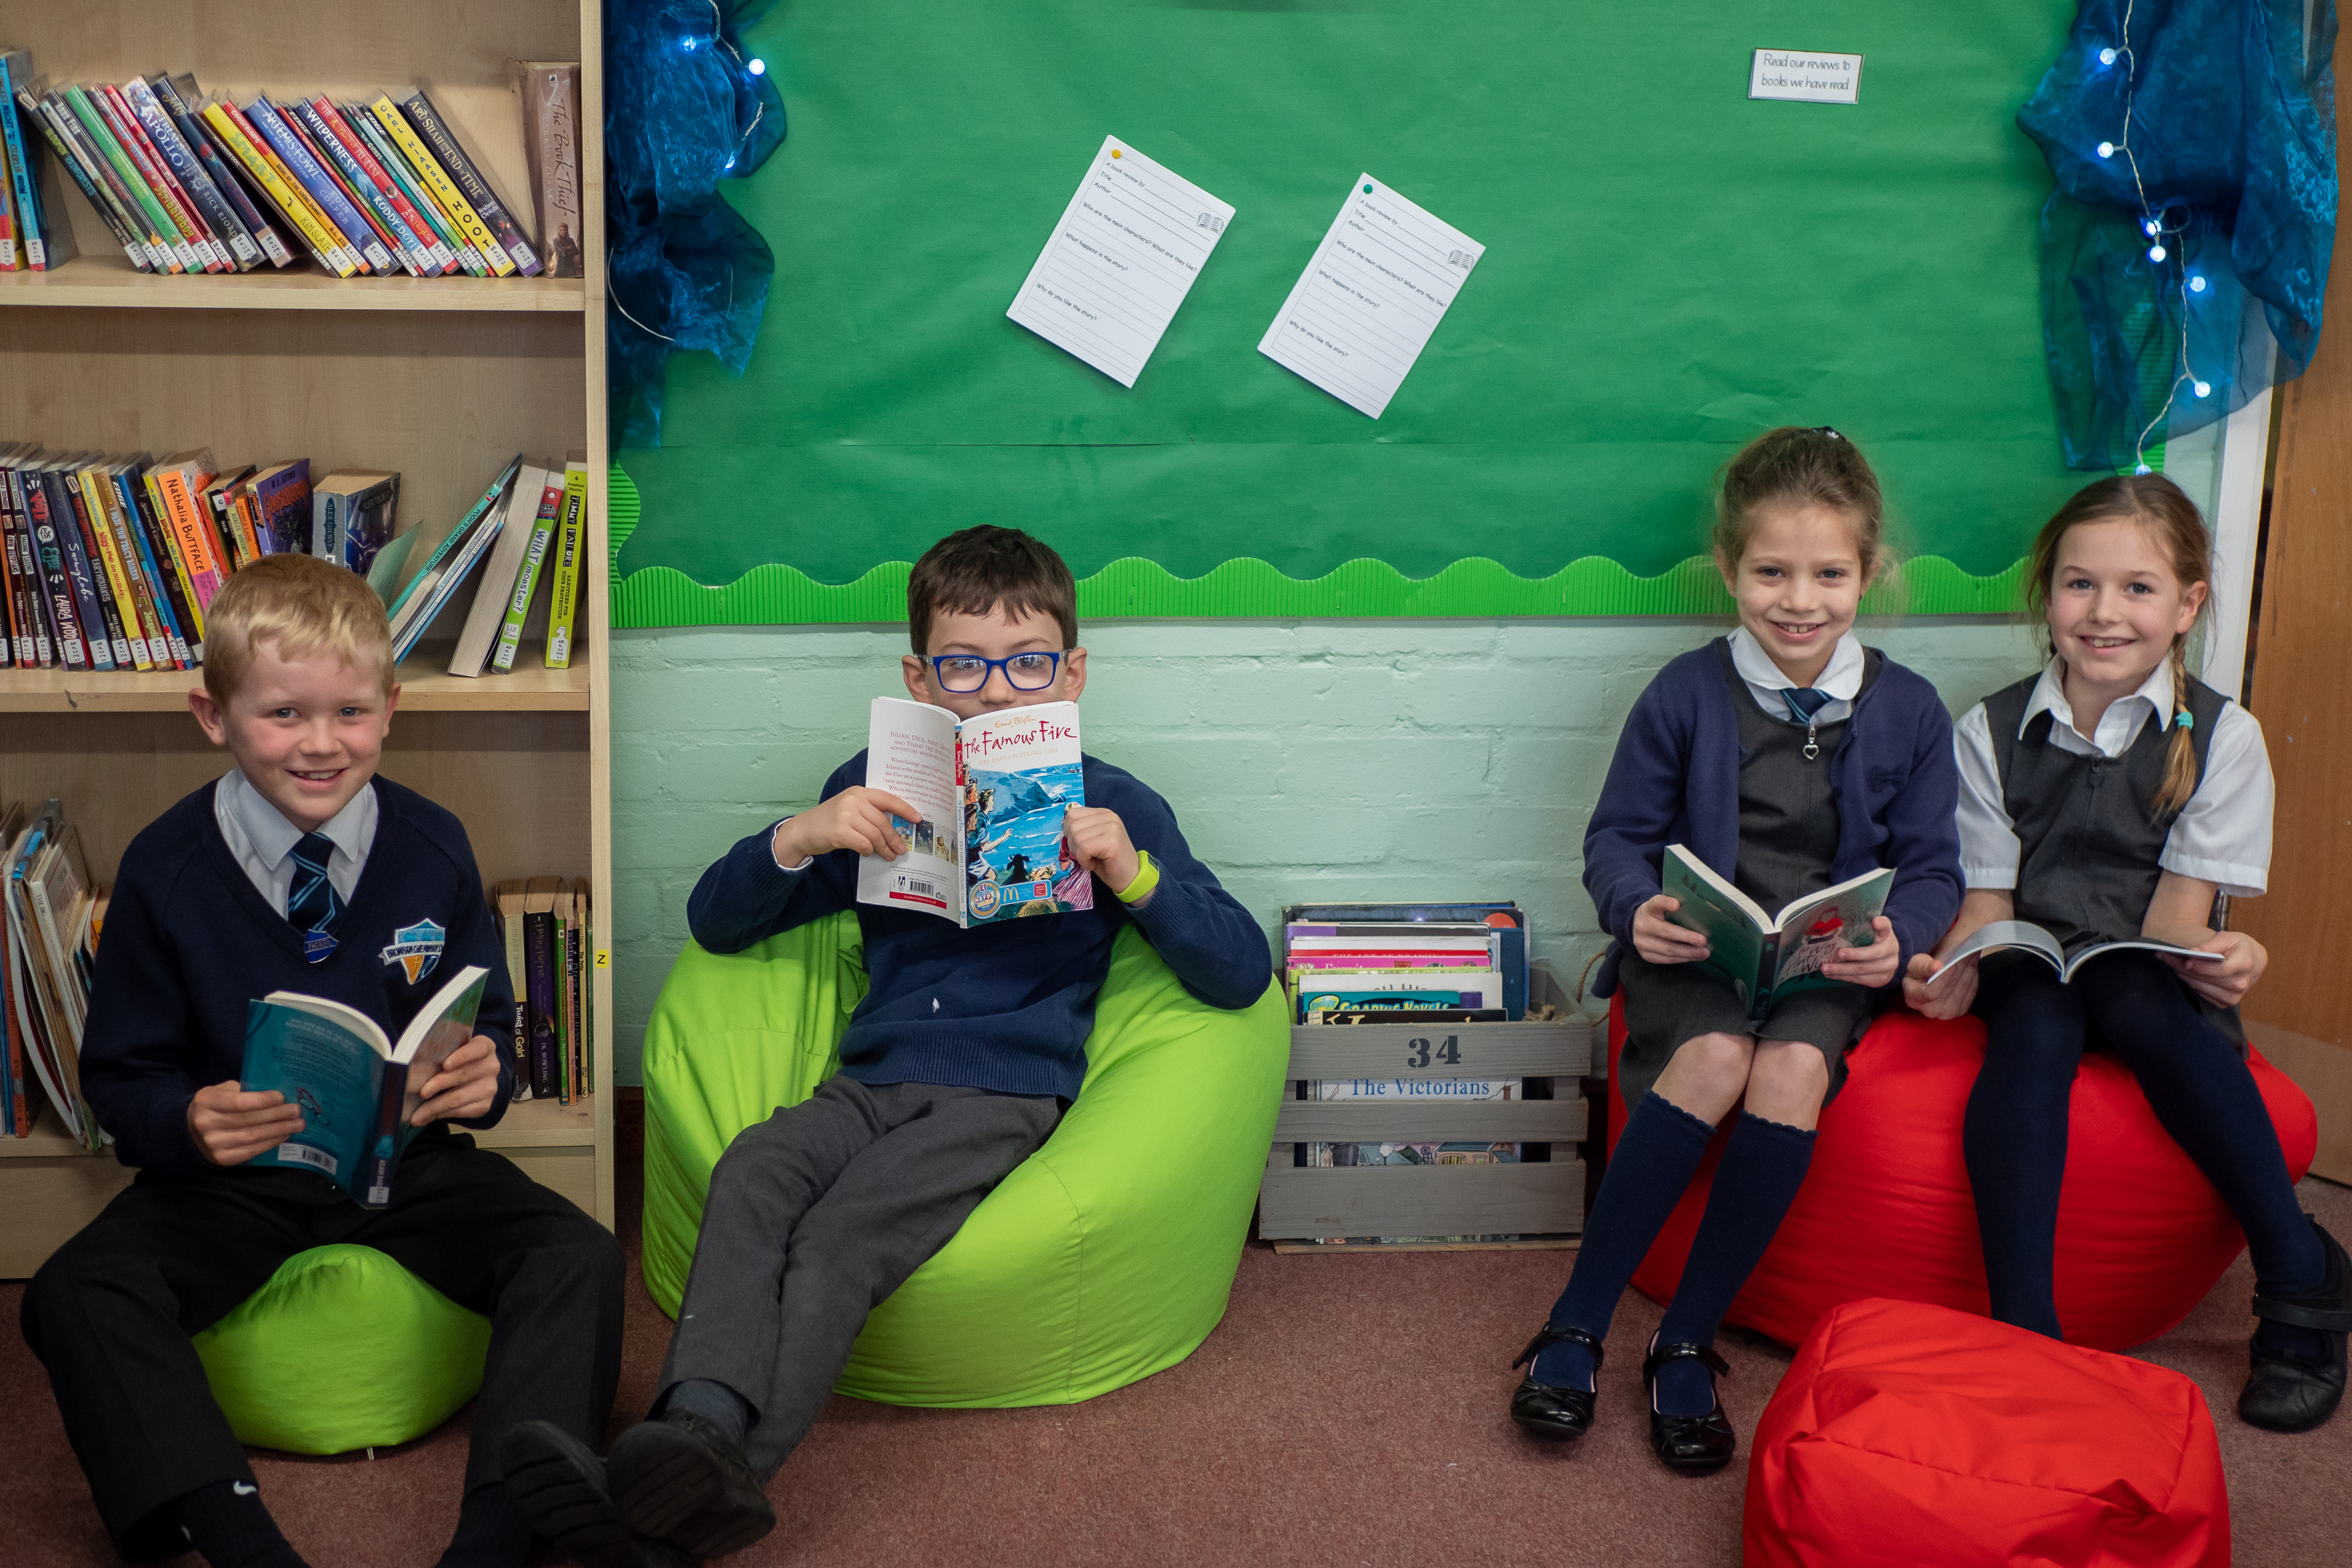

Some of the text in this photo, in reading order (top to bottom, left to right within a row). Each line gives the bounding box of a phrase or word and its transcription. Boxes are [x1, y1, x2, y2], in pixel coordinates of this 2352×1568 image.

[1763, 52, 1850, 71] Read our reviews to
[1762, 73, 1849, 90] books we have read
[142, 109, 186, 169] APOLLO
[156, 113, 185, 152] TRIALS
[228, 108, 261, 145] GOOSEBUMPS
[288, 109, 311, 137] EDGE
[364, 109, 387, 138] EDGE
[226, 128, 279, 187] SMART
[261, 107, 322, 181] ARTEMIS FOWL
[304, 109, 358, 174] WILDERNESS
[408, 97, 484, 199] ARU SHAH END TIME
[541, 112, 555, 201] MARKUS ZUSAK
[549, 97, 576, 217] The Book Thief
[62, 154, 98, 197] RAINFORESTS
[284, 149, 310, 181] DECEPTION
[379, 103, 493, 250] CARL HIAASEN HOOT
[1099, 170, 1113, 181] Title
[1110, 164, 1146, 189] book review by
[16, 174, 27, 194] NOON
[202, 190, 220, 212] RICK
[275, 163, 323, 218] BRIDE LIVING DUMMY
[1094, 181, 1112, 195] Author
[153, 181, 198, 239] Scribbleboy
[318, 187, 350, 226] COLFER
[329, 189, 351, 215] EOIN
[372, 194, 401, 228] RODDY
[1375, 209, 1392, 221] review
[299, 215, 316, 233] KIM
[406, 211, 436, 245] McLaughlin
[1082, 201, 1198, 273] Who are the main characters? What are they like?
[1347, 219, 1365, 232] Author
[1064, 231, 1128, 273] What happens the story?
[1035, 282, 1048, 293] Why
[1053, 294, 1064, 303] you
[1062, 298, 1073, 307] like
[1071, 303, 1082, 313] the
[1080, 309, 1097, 323] story?
[1317, 269, 1380, 311] What happens story?
[112, 480, 126, 509] EDGE
[282, 470, 296, 485] STINE
[26, 488, 51, 526] VOTE
[165, 477, 189, 525] Nathalia
[198, 499, 210, 521] FICTION
[40, 528, 52, 540] for
[231, 512, 249, 556] BERLIE DOHERTY
[238, 505, 253, 543] PUDDLE LANE
[420, 507, 482, 573] POOH'S GRAND ADVENTURE
[561, 495, 580, 568] TIMMY FAILURE
[8, 549, 20, 575] EGYPTIANS
[109, 510, 140, 582] DARE YOU TRACY BEAKER
[23, 555, 34, 574] SAXONS
[62, 541, 95, 604] Snowglobe
[90, 557, 111, 602] EARTHQUAKES
[109, 564, 126, 597] ON HOLIDAY
[511, 528, 547, 612] WHAT monster?
[51, 591, 74, 621] LAURA
[180, 575, 196, 609] VIVIAN FRENCH
[555, 585, 566, 619] PROTECTION
[563, 574, 572, 605] SANITIZED
[995, 715, 1037, 729] Enid Blyton
[890, 746, 939, 761] ADVENTURE WHEREVER
[906, 741, 924, 750] TIMMY
[964, 720, 1077, 759] The Famous Five
[1013, 750, 1042, 759] PUZZLING
[905, 759, 920, 768] George
[912, 775, 928, 784] journey
[975, 891, 996, 904] HAPPY
[534, 923, 546, 979] HARRY POTTER
[513, 1004, 525, 1058] Twist Gold
[1408, 1035, 1462, 1068] 34
[1349, 1077, 1490, 1096] The Victorians
